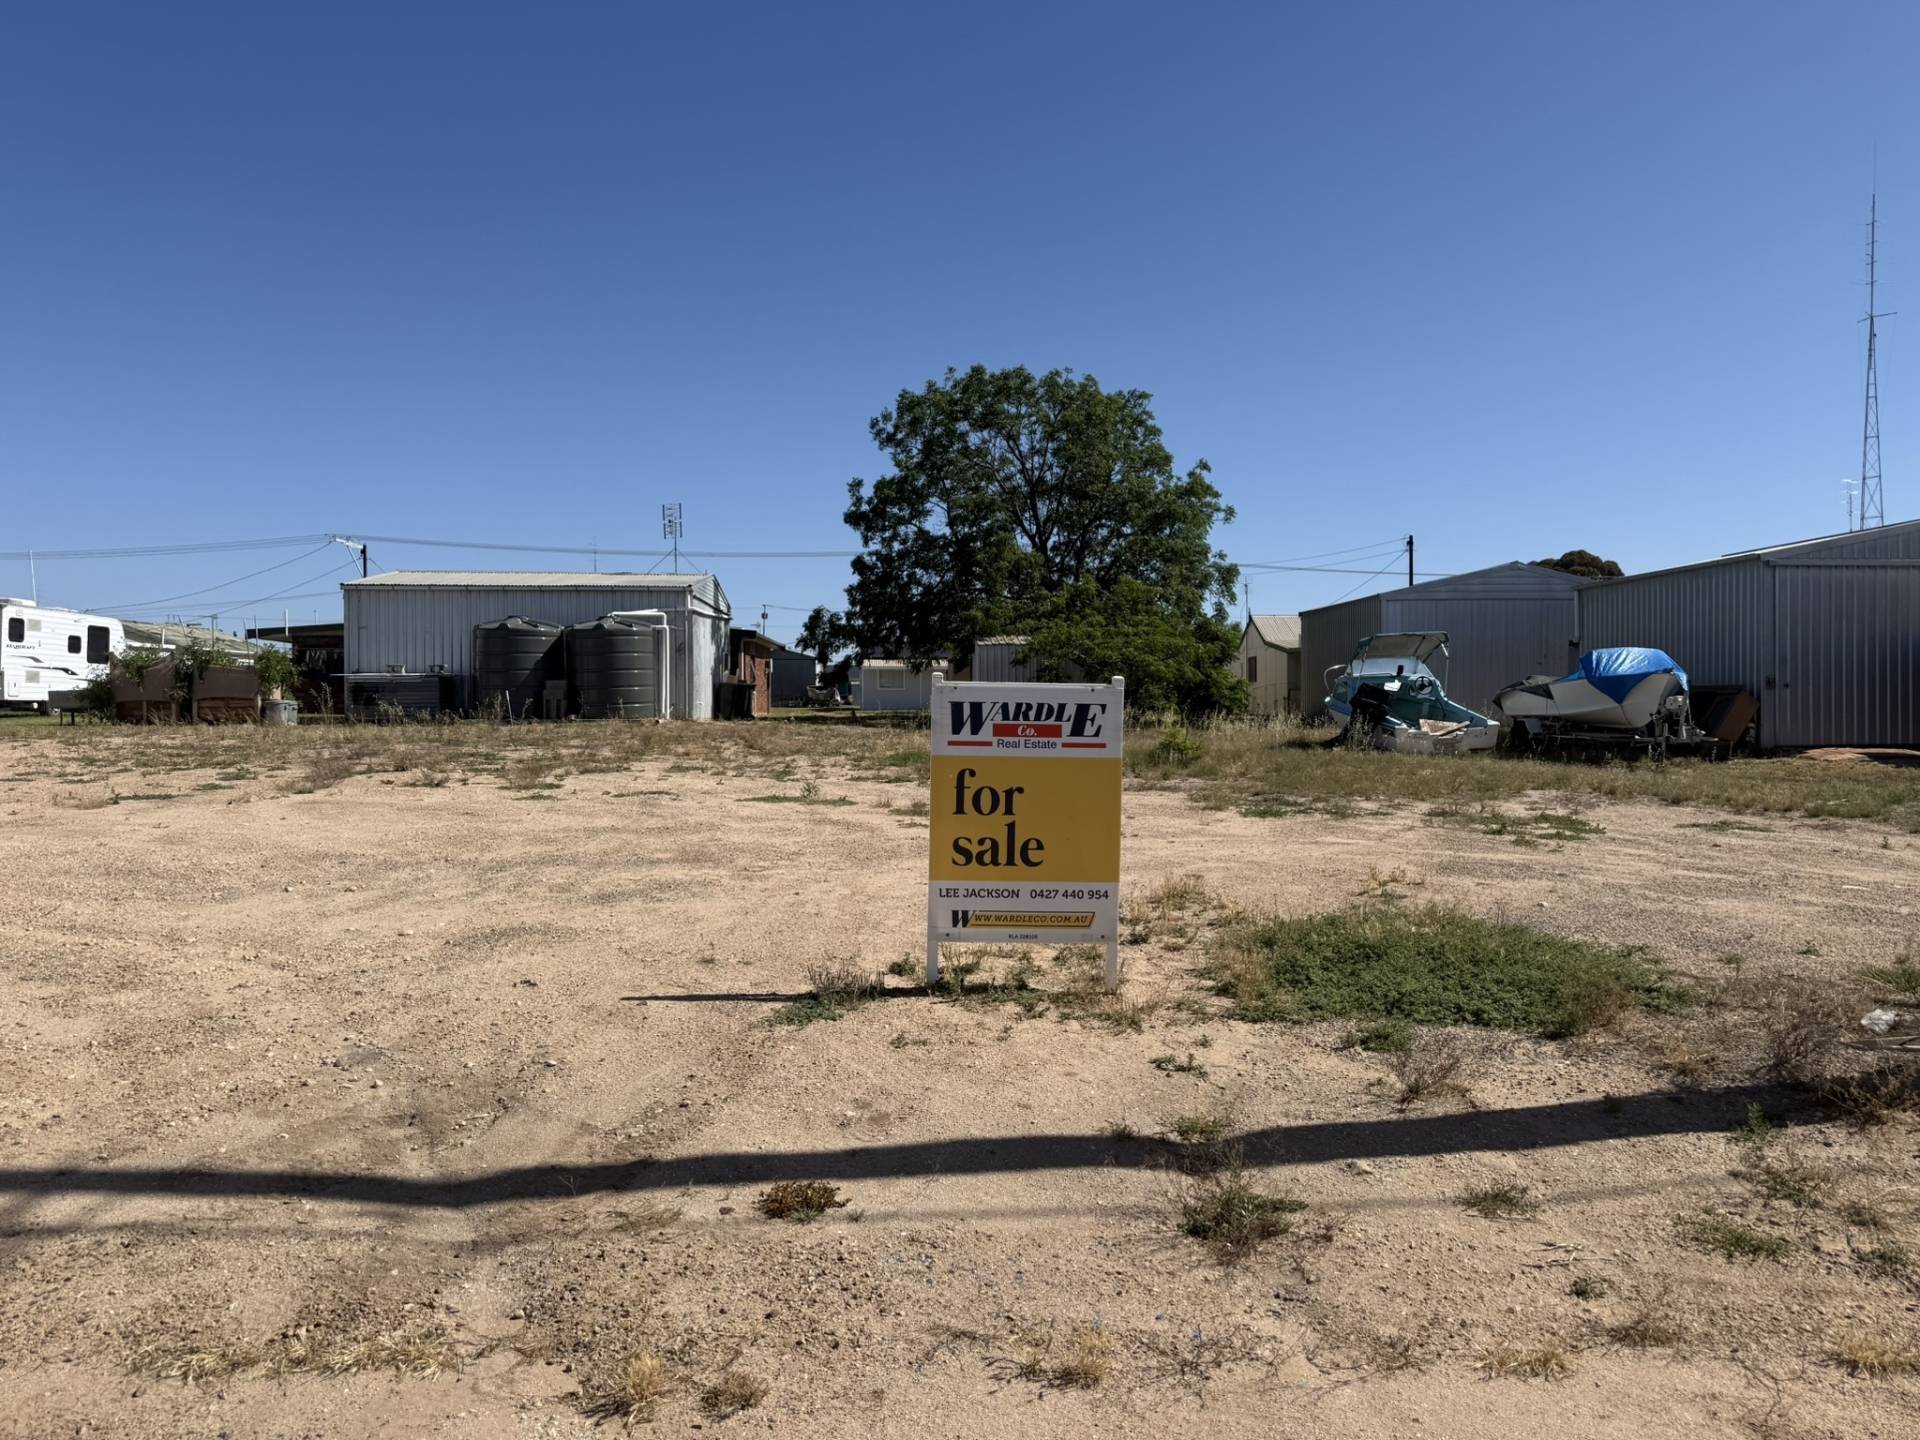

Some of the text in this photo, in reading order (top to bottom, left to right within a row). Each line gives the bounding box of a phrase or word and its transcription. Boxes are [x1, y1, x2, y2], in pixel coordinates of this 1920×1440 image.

[948, 700, 1107, 738] WARDLE
[1017, 726, 1037, 737] Co.
[997, 739, 1057, 749] Real Estate
[952, 768, 1025, 816] for
[951, 820, 1046, 868] sale
[939, 888, 1109, 900] LEE JACKSON 0427 440 954
